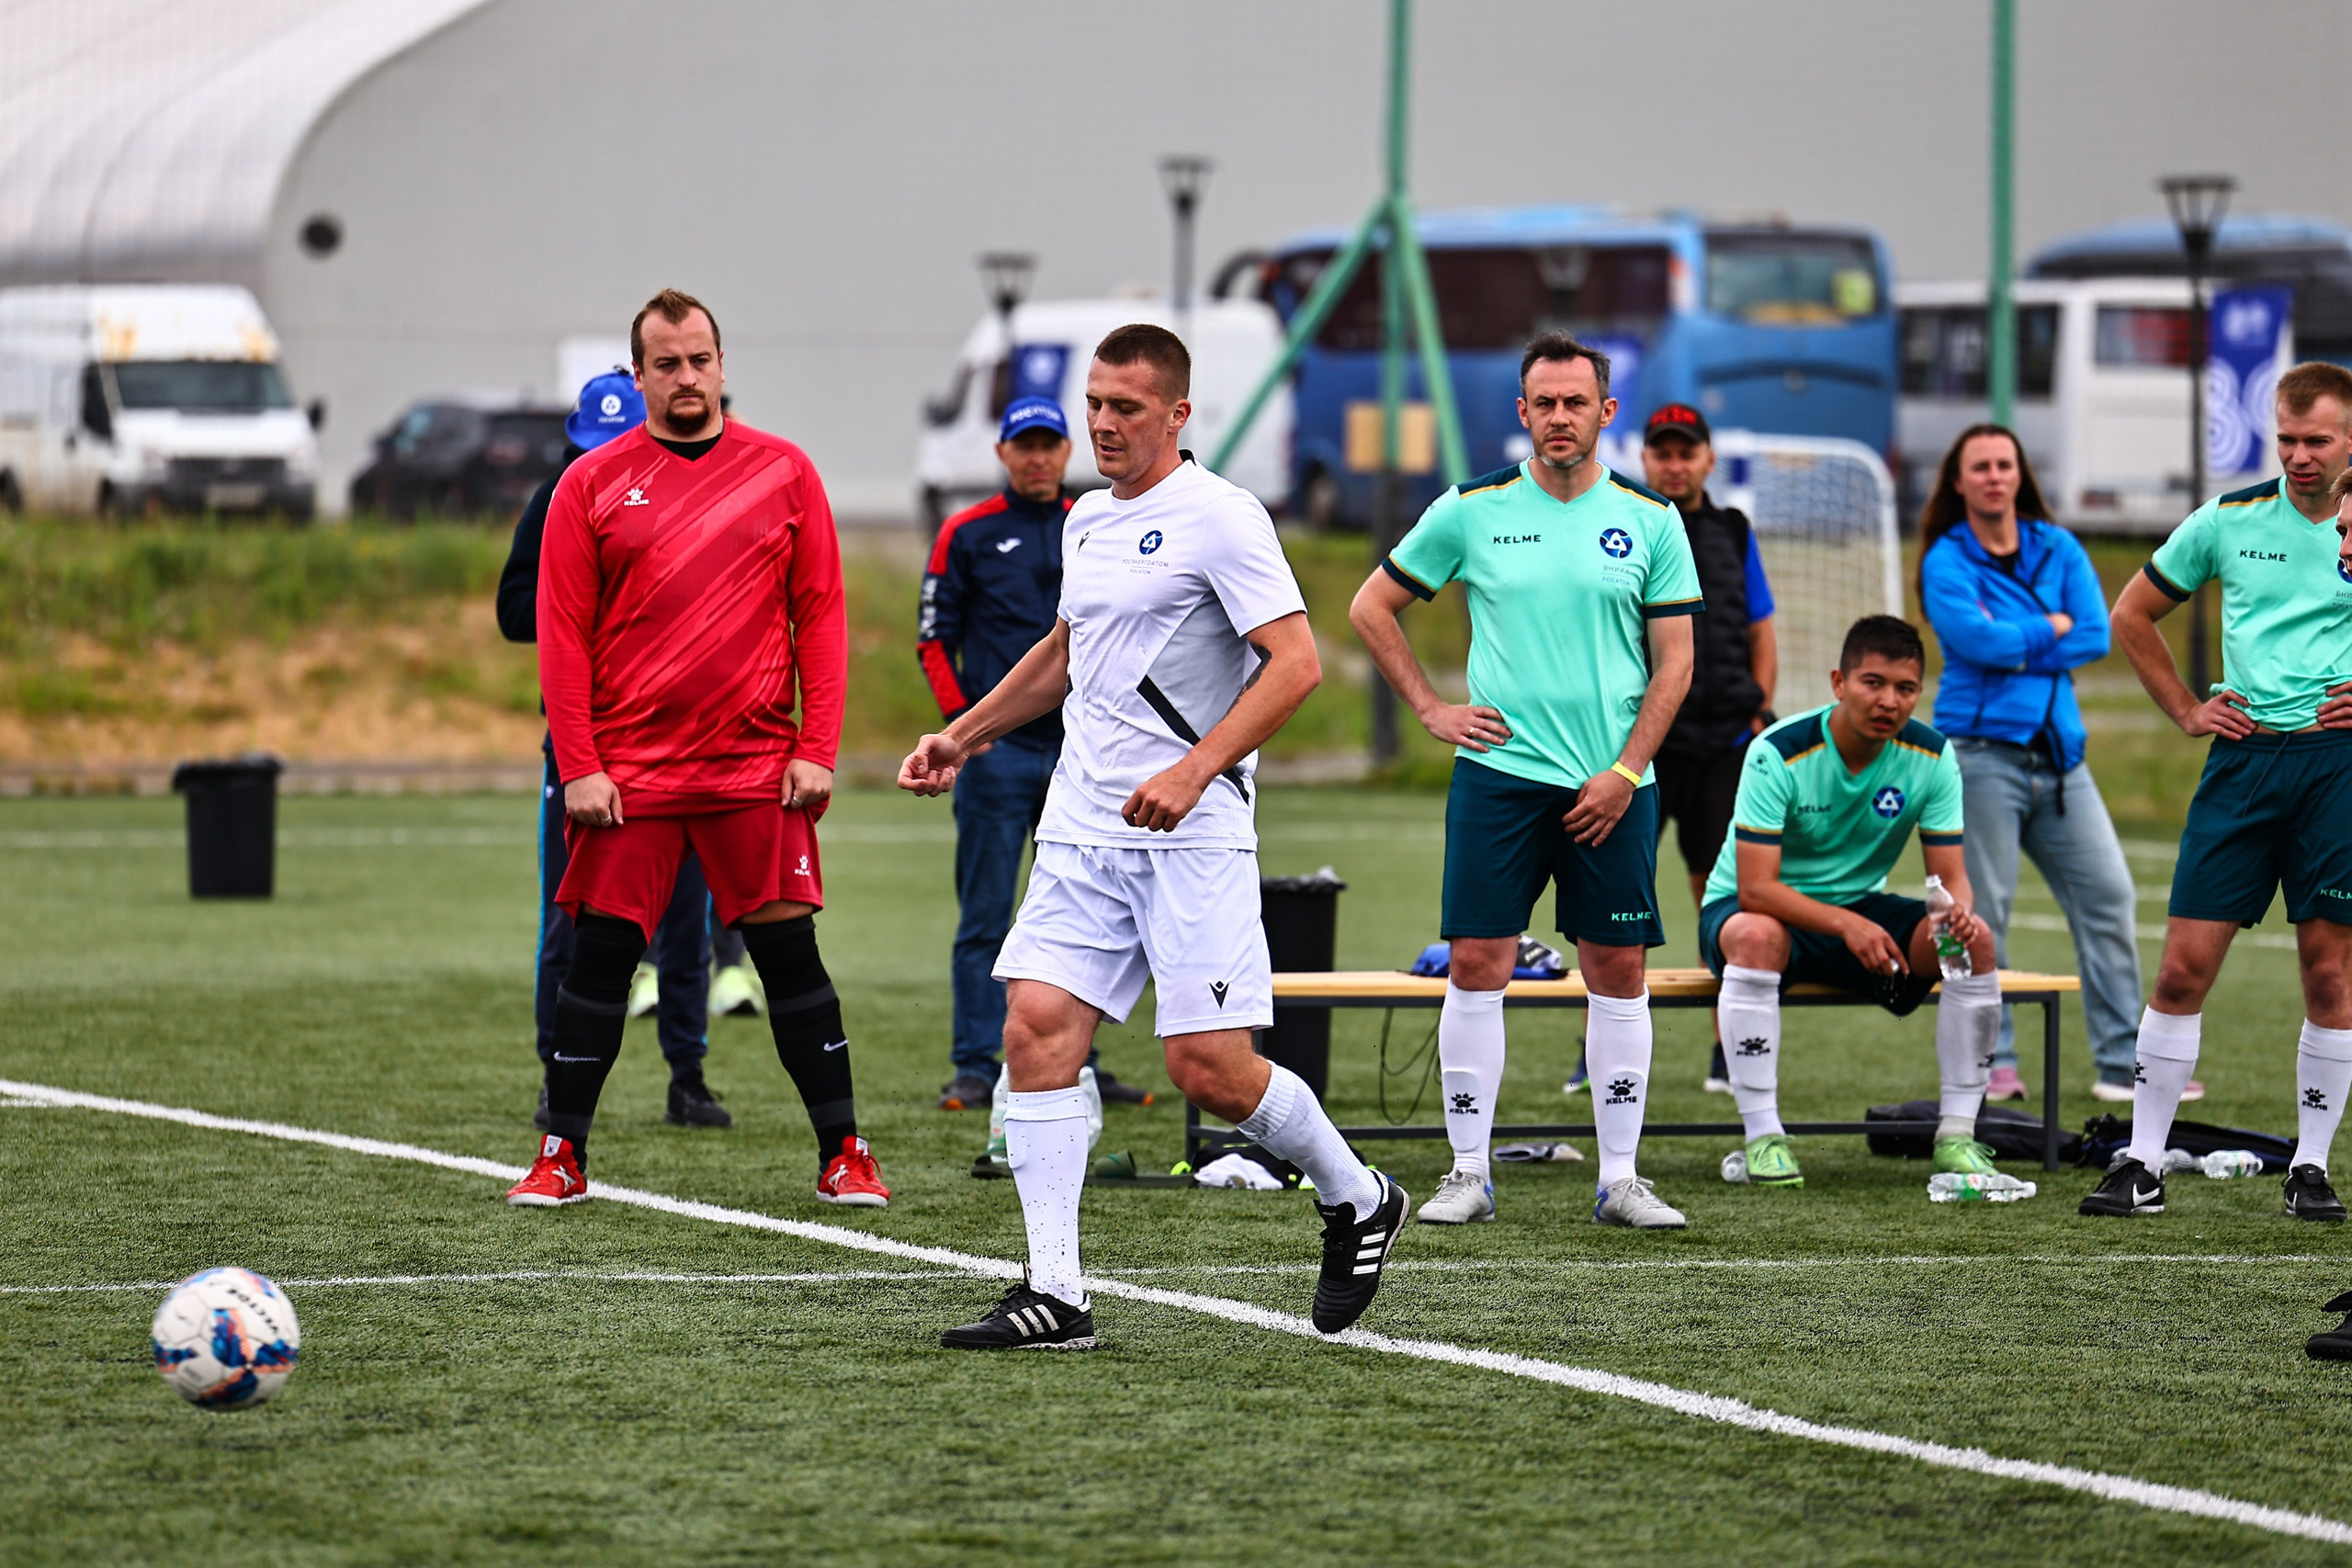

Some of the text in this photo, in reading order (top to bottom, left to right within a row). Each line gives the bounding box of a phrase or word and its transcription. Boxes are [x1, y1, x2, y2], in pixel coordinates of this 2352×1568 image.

[1493, 535, 1542, 544] KELME
[2240, 549, 2288, 562] KELME
[1611, 912, 1652, 921] KELME
[1606, 1096, 1637, 1105] KELME
[2301, 1100, 2327, 1111] KELME
